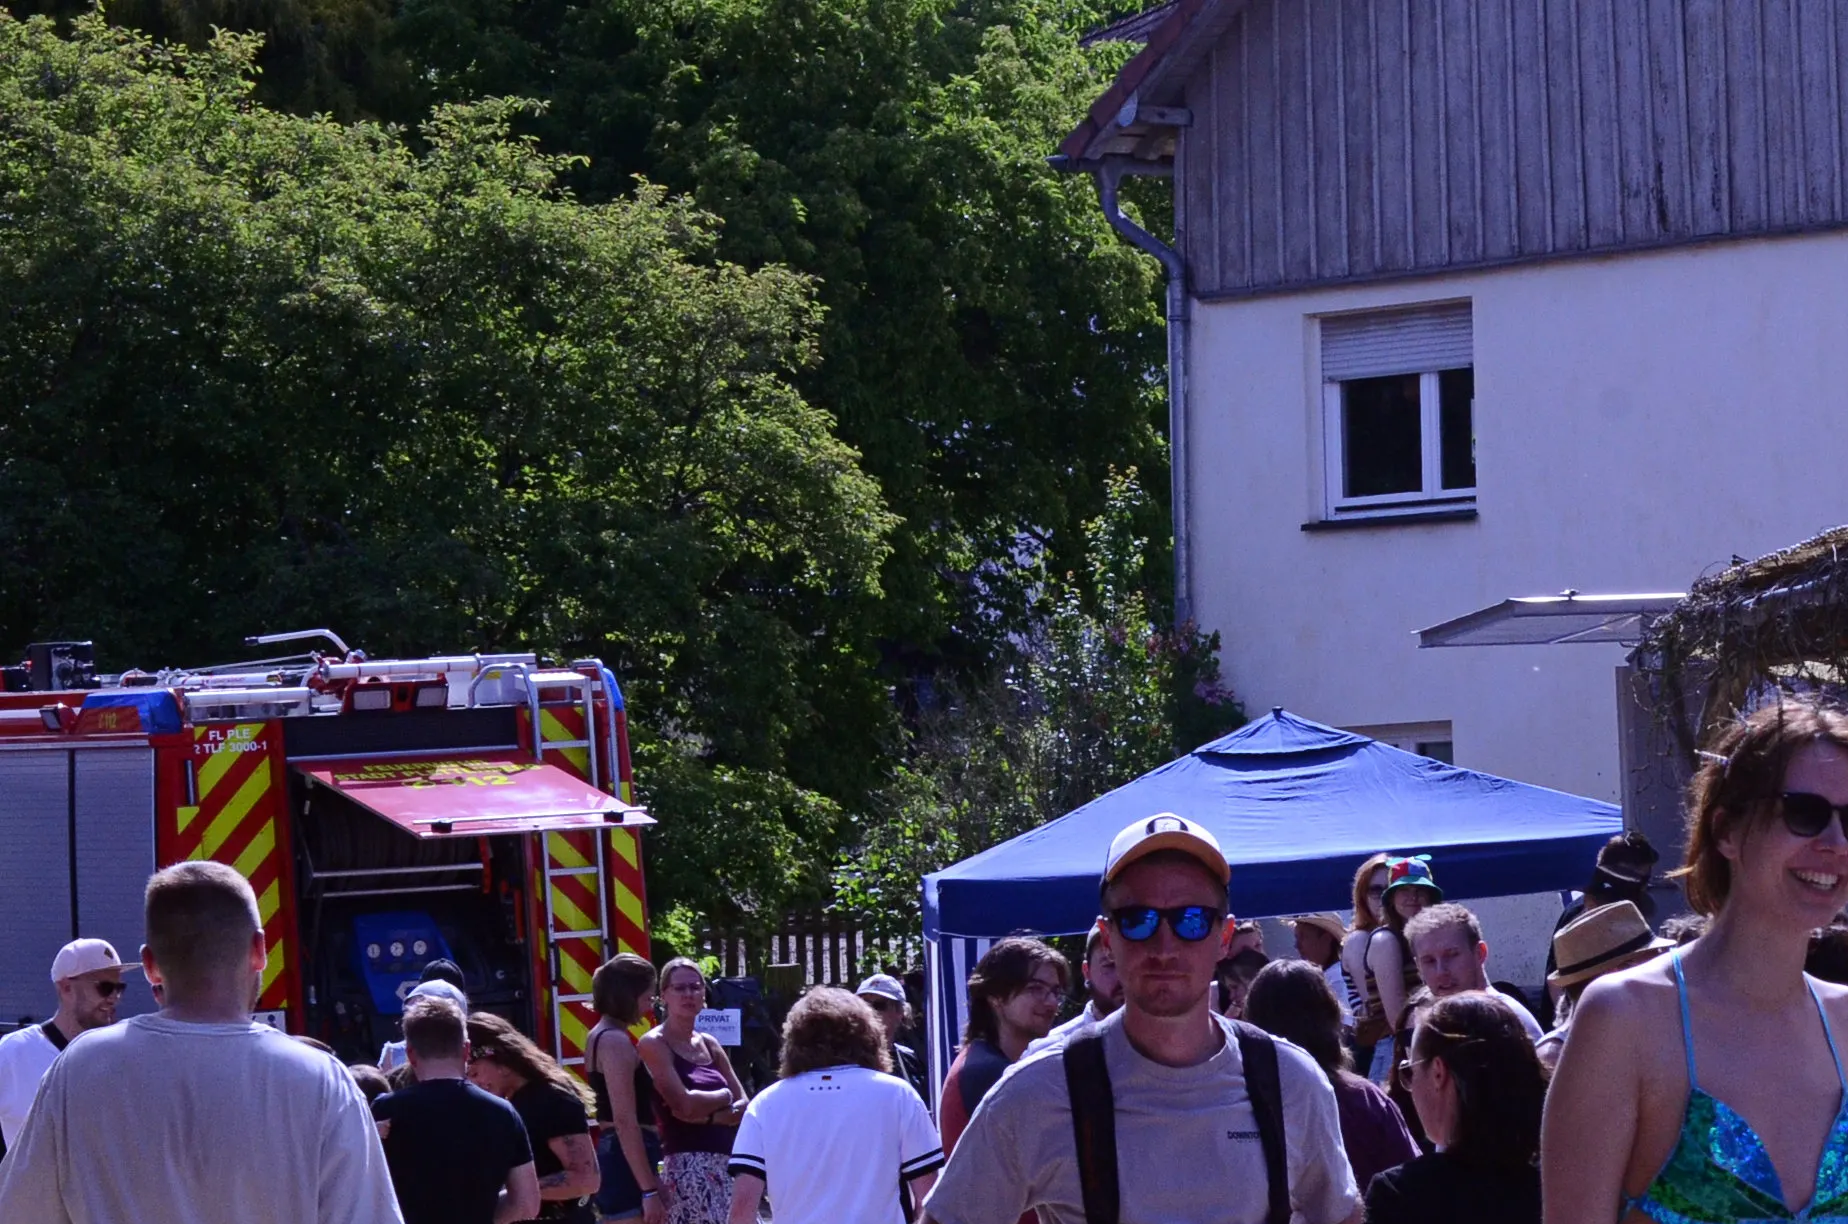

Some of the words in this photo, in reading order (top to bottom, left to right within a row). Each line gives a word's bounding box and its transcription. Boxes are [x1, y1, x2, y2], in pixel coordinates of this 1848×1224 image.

[208, 730, 224, 741] FL
[226, 728, 251, 740] PLE
[203, 742, 226, 754] TLF
[229, 740, 268, 753] 3000-1
[698, 1015, 730, 1023] PRIVAT
